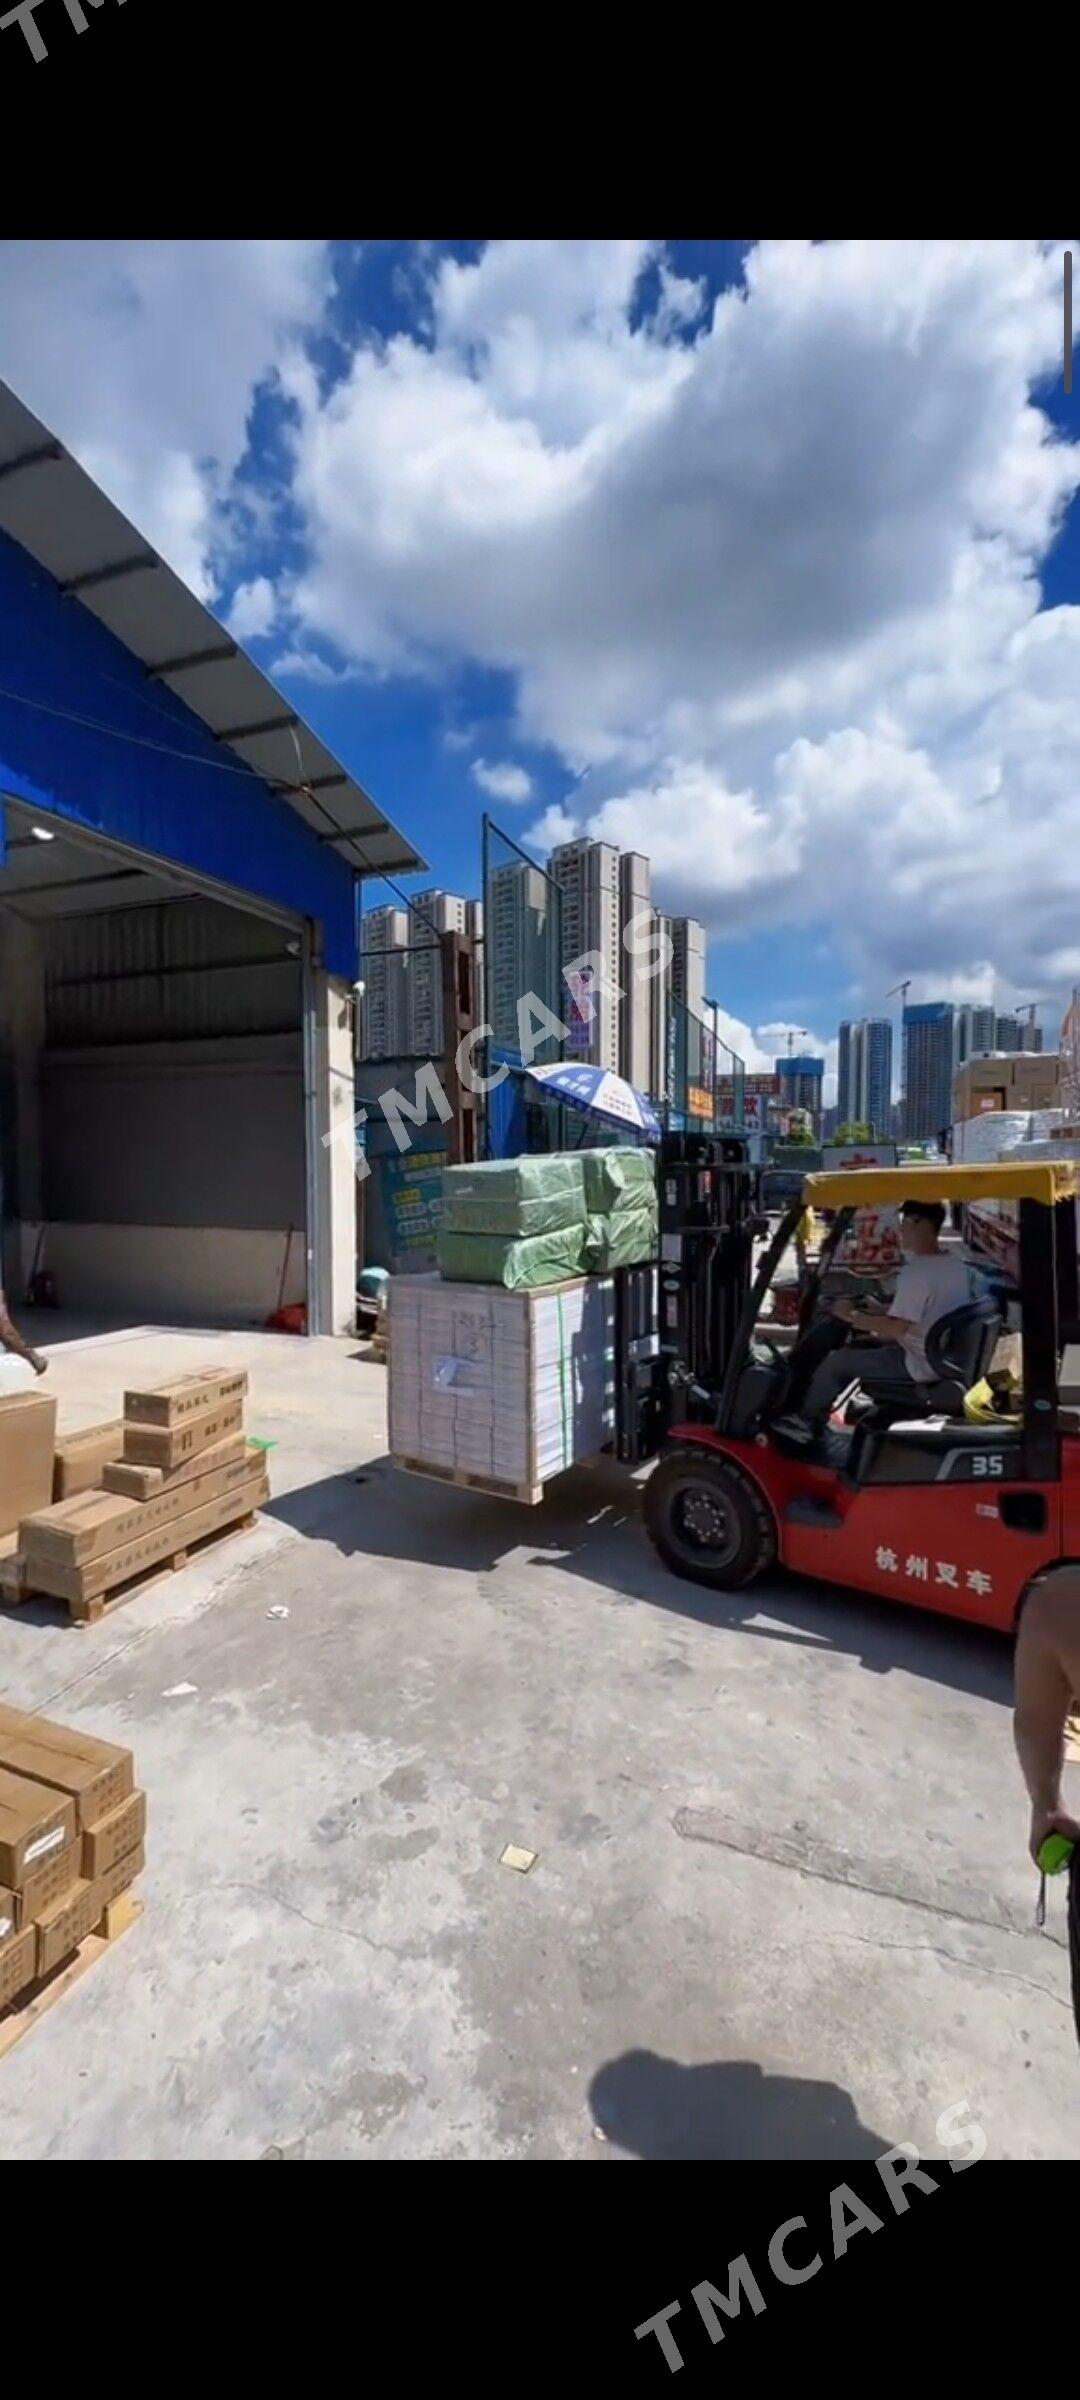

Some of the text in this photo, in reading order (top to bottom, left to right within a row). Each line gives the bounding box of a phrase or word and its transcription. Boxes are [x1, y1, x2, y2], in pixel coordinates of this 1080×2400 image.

[972, 1454, 1004, 1476] 35
[875, 1545, 993, 1596] 杭州叉车
